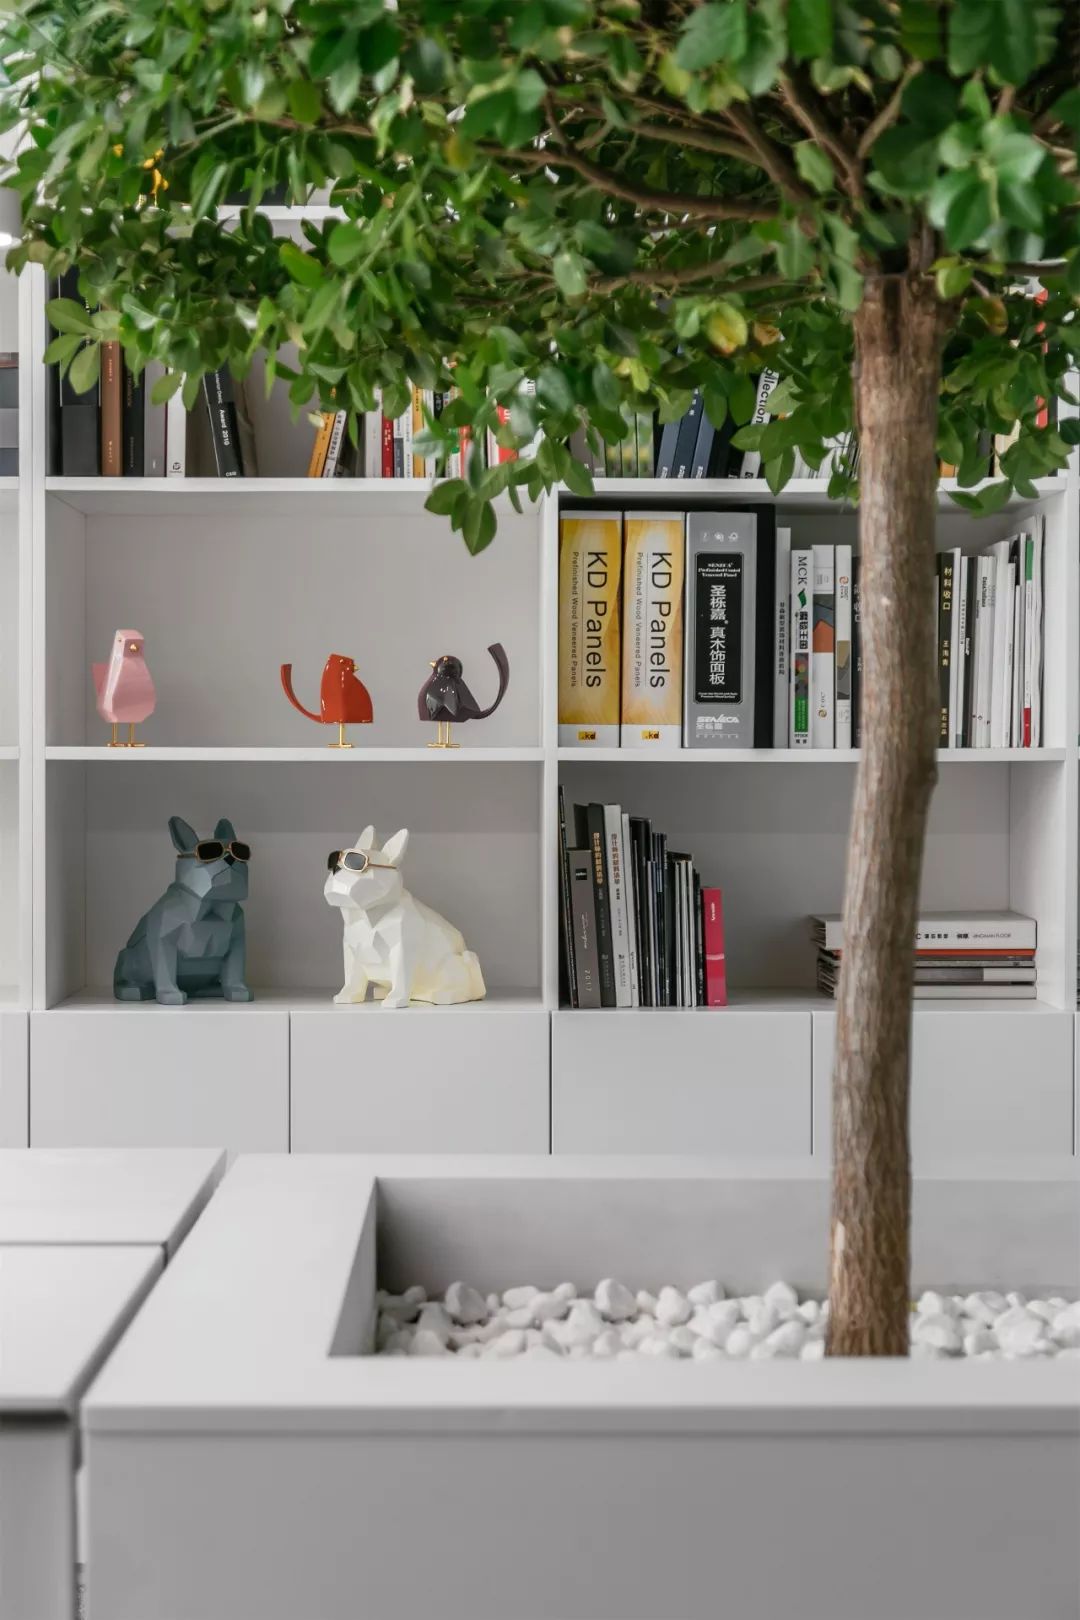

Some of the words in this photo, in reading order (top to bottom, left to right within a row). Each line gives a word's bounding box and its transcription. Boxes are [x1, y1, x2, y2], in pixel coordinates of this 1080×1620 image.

[572, 551, 580, 595] Prefinished
[587, 551, 608, 589] KD
[636, 552, 644, 595] Prefinished
[651, 551, 672, 589] KD
[798, 556, 808, 585] MCK
[586, 601, 608, 688] Panels
[650, 601, 672, 688] Panels
[709, 627, 726, 685] 真木饰面板
